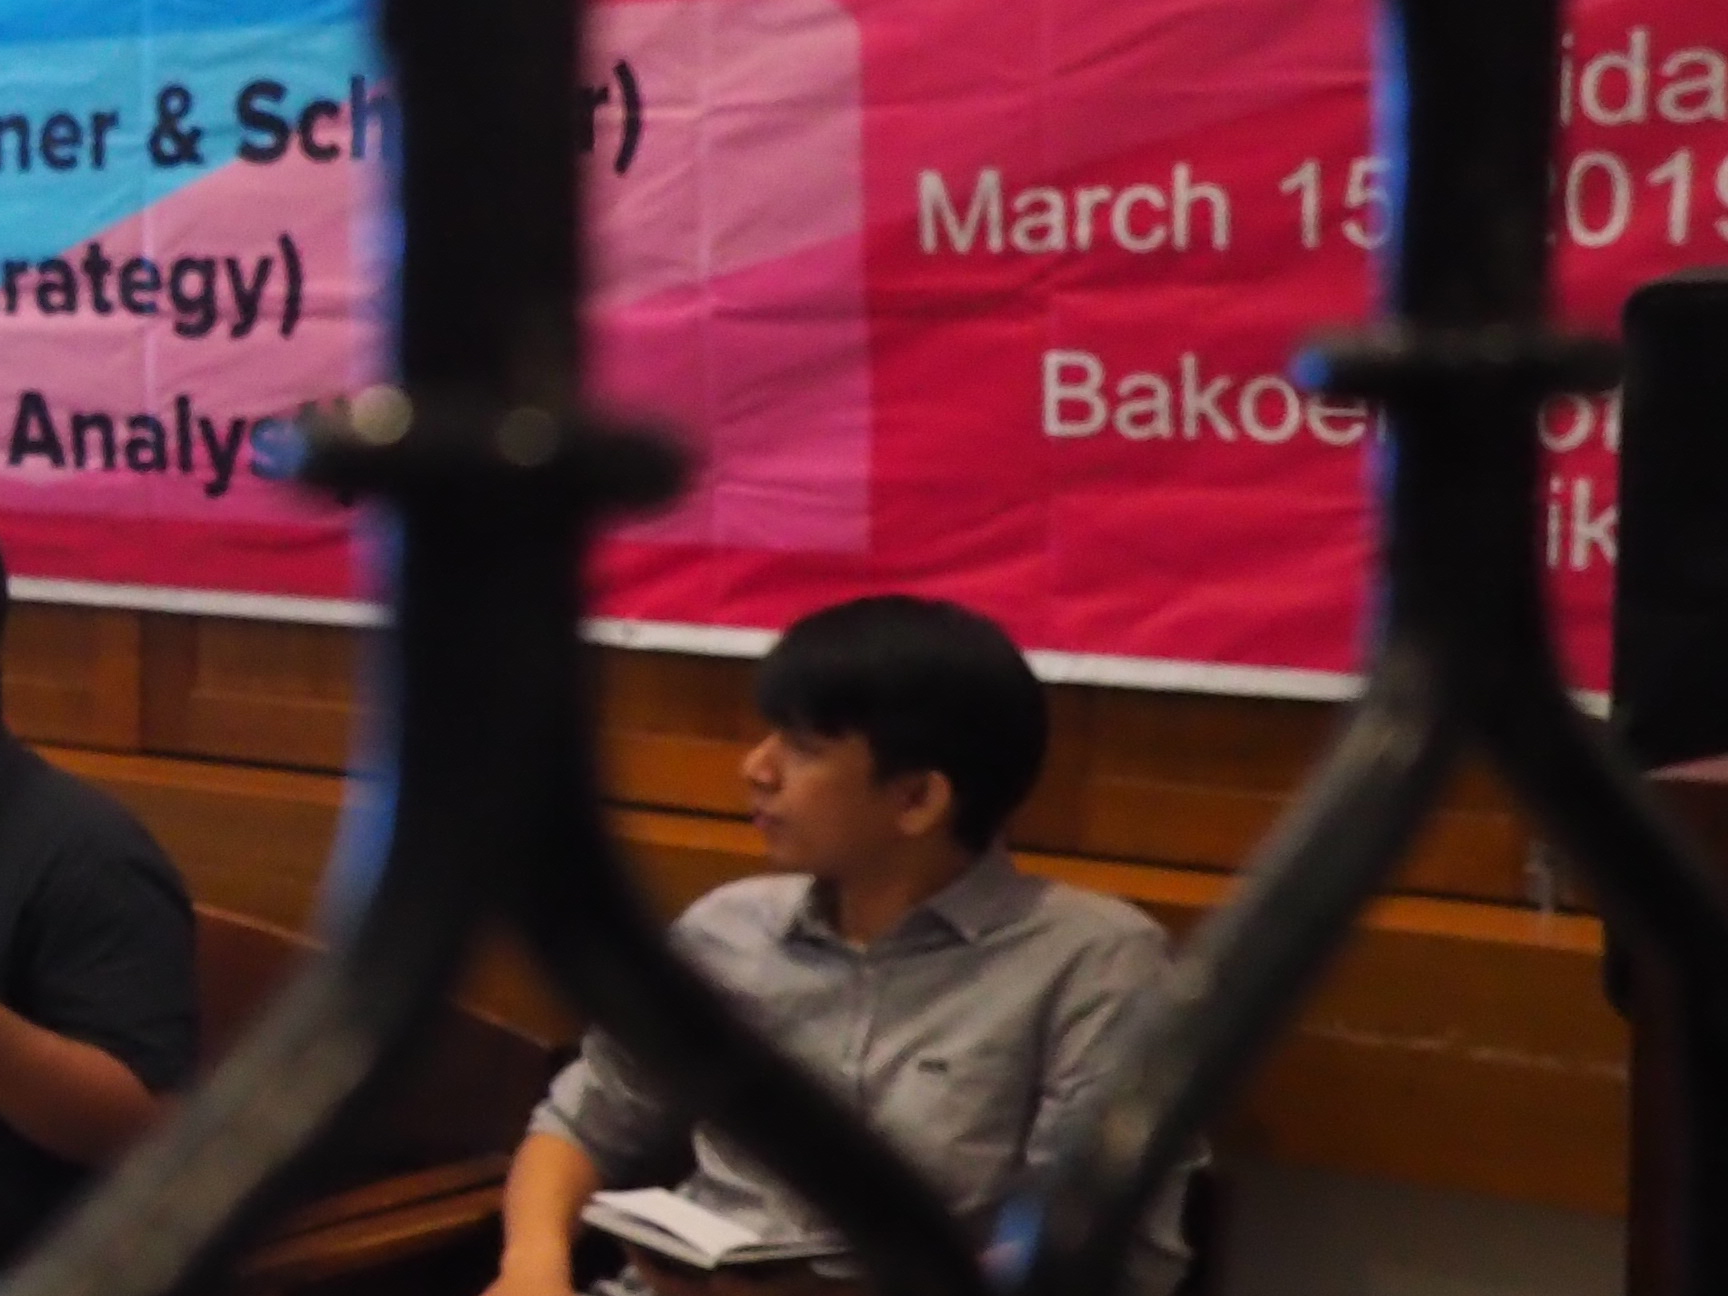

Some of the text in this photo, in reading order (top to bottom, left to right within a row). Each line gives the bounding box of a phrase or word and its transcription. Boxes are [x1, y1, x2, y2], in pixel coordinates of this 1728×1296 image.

[148, 82, 205, 168] &
[234, 58, 644, 176] Schr)
[917, 161, 1232, 255] March
[7, 388, 312, 500] Analys
[1041, 348, 1390, 447] Bakoe
